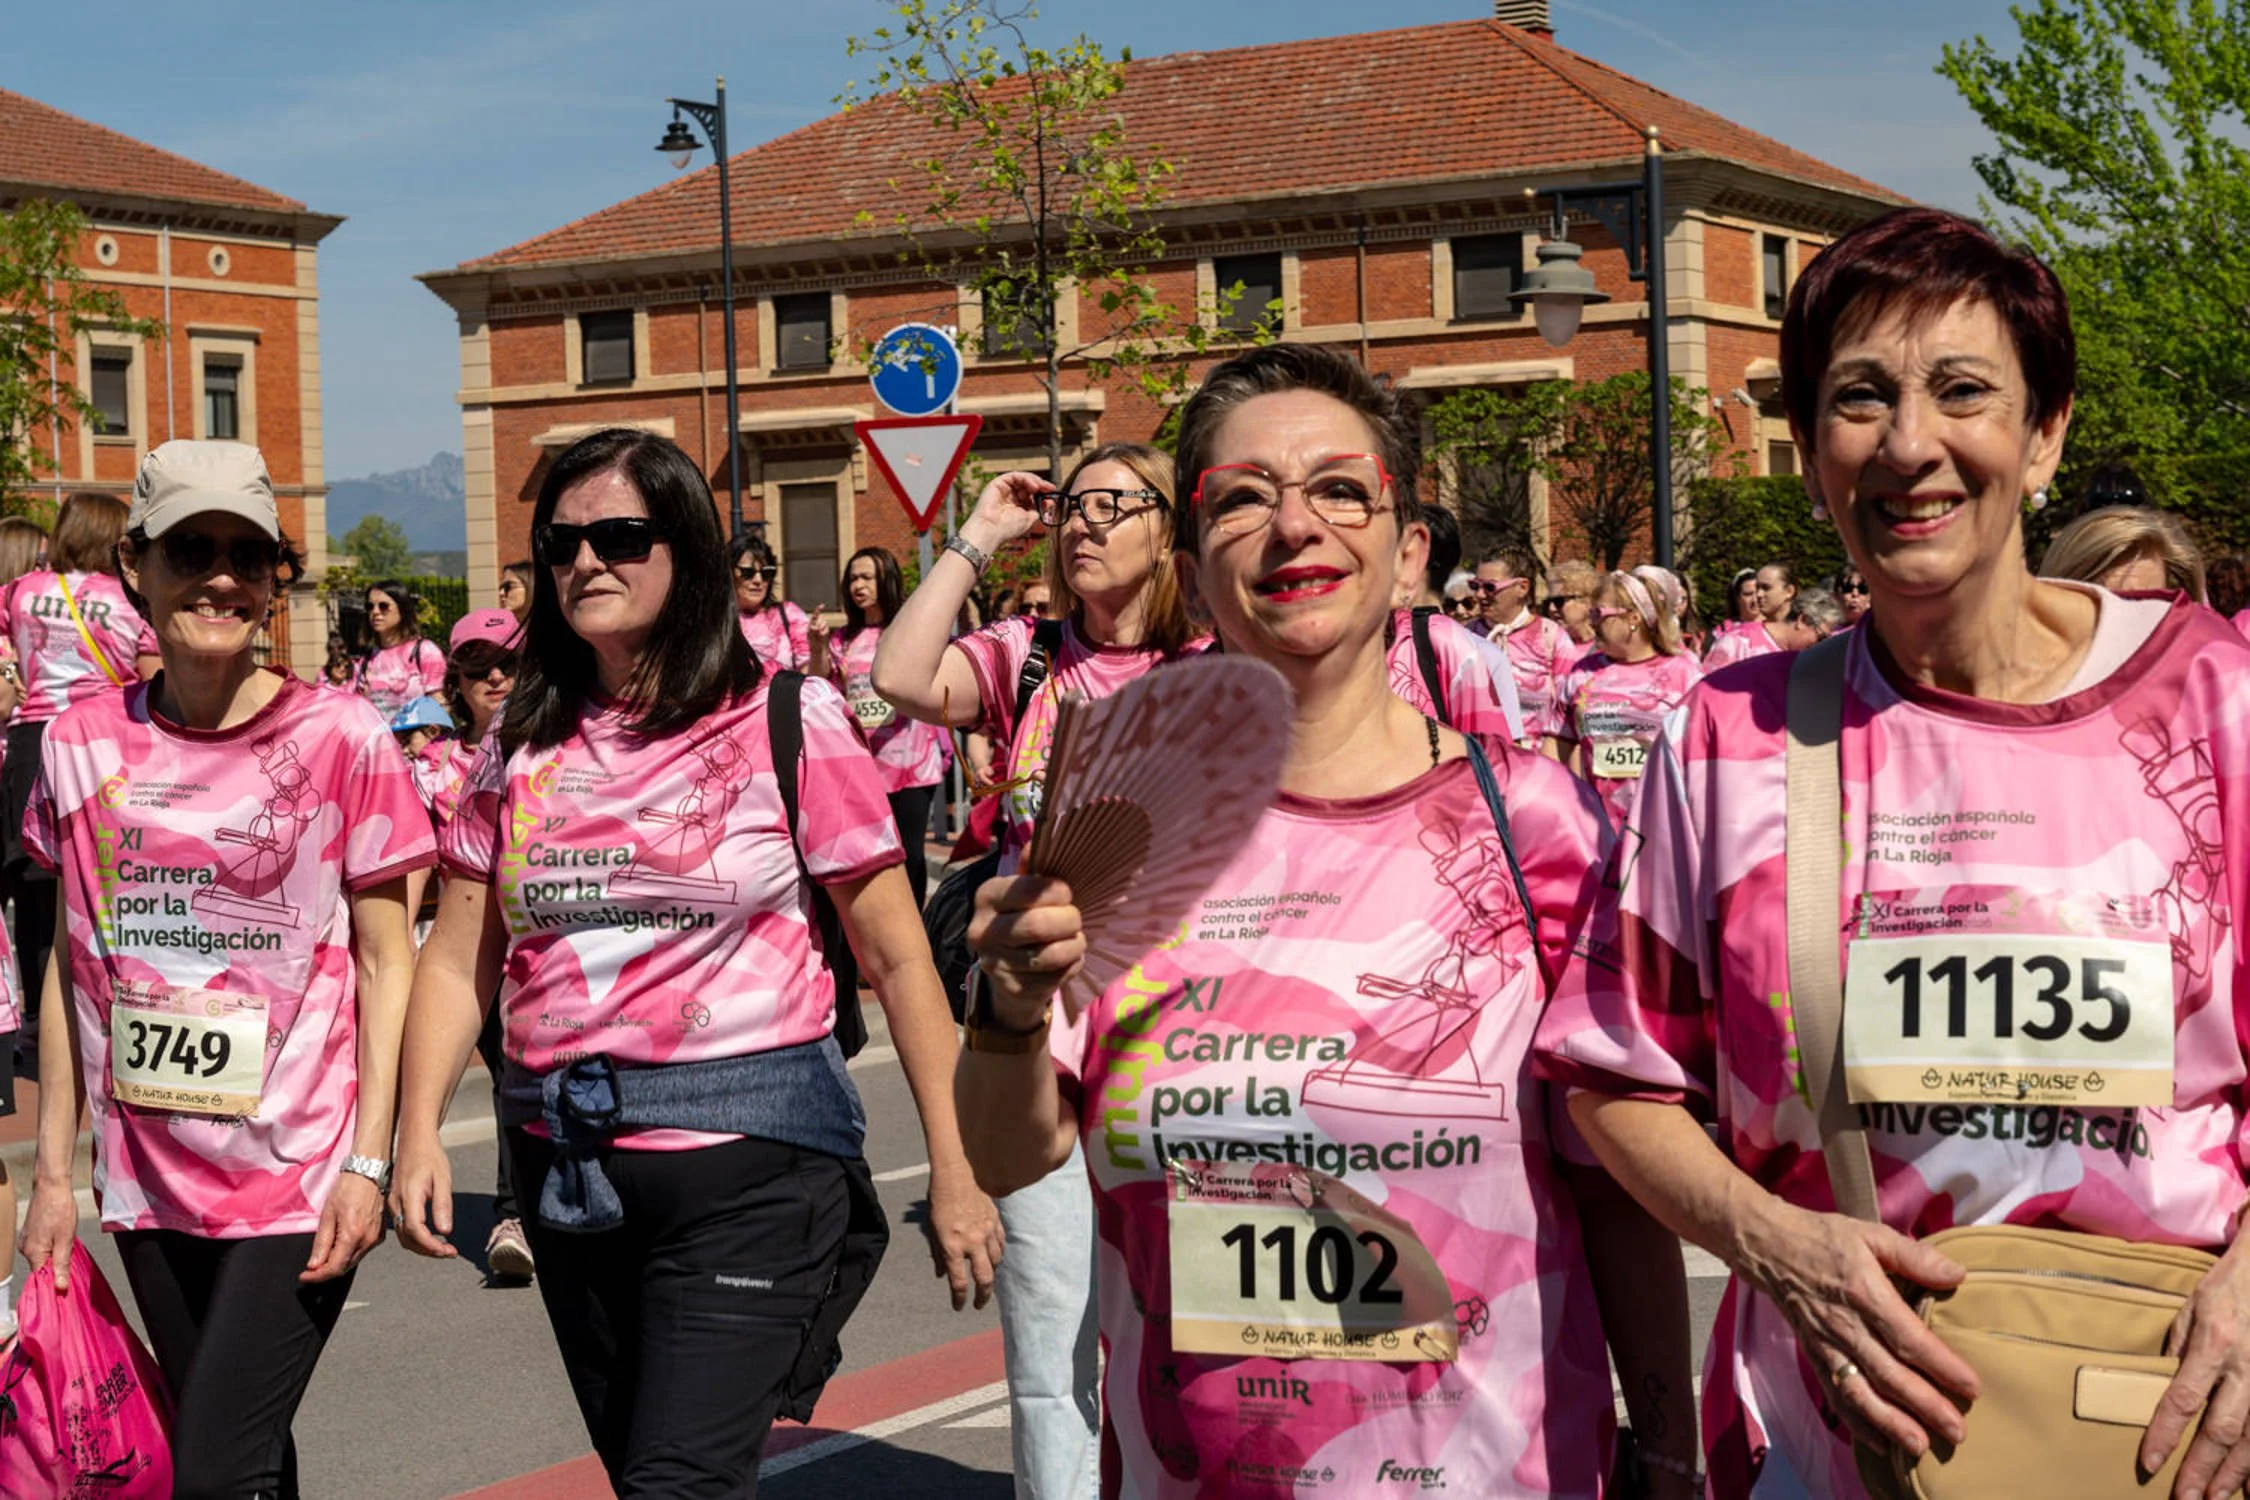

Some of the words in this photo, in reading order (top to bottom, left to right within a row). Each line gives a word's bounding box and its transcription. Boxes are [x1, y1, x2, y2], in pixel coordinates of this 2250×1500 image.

[1605, 747, 1646, 765] 4512
[1869, 811, 1951, 827] sociación
[1955, 810, 2037, 825] española
[118, 828, 142, 850] XI
[1869, 828, 1916, 845] ontra
[1920, 828, 1935, 845] el
[526, 842, 633, 868] Carrera
[1884, 847, 1905, 862] La
[1910, 849, 1953, 866] Rioja
[117, 859, 213, 885] Carrera
[523, 881, 570, 908] por
[576, 876, 602, 901] la
[117, 895, 159, 920] por
[164, 893, 187, 917] la
[529, 905, 715, 934] Investigación
[1894, 905, 1945, 918] Carrera
[1947, 904, 1970, 915] por
[1974, 901, 1989, 913] la
[117, 924, 282, 954] Investigación
[1218, 927, 1235, 940] La
[1174, 977, 1223, 1013] XI
[1883, 955, 2132, 1044] 11135
[126, 1020, 231, 1078] 3749
[1163, 1027, 1347, 1063] Carrera
[1100, 963, 1169, 1171] mujer
[1151, 1084, 1234, 1128] por
[1245, 1076, 1291, 1118] la
[1152, 1127, 1482, 1178] Investigación
[1207, 1174, 1254, 1186] Carrera
[1256, 1178, 1276, 1189] por
[1221, 1223, 1404, 1305] 1102
[1263, 1329, 1319, 1346] NATUR
